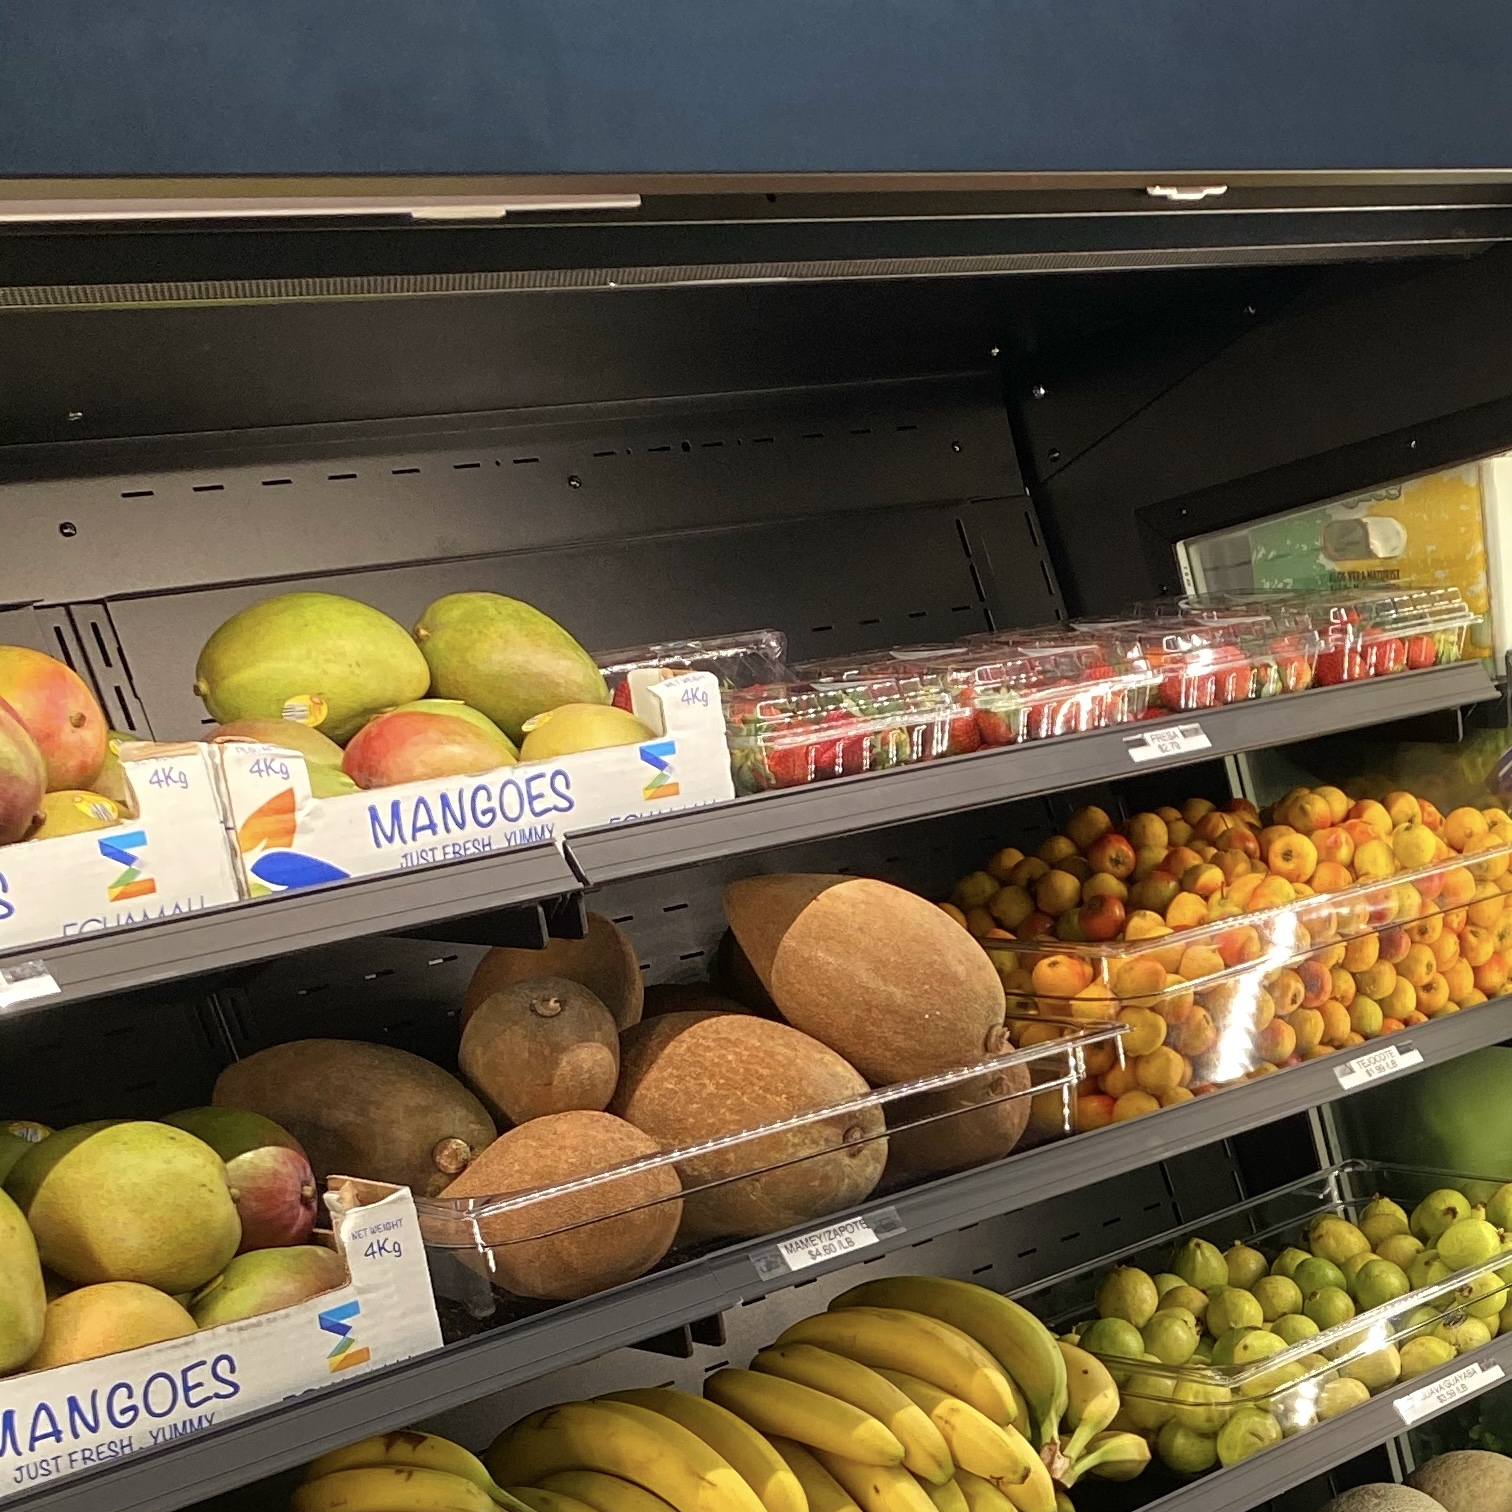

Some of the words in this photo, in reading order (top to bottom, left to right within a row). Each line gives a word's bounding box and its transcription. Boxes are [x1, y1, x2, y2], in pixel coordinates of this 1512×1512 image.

[681, 687, 709, 707] 4Kg
[1149, 731, 1179, 743] FRESA
[149, 767, 189, 789] 4Kg
[249, 757, 290, 780] 4Kg
[368, 769, 575, 849] MANGOES
[504, 823, 556, 846] YUMMY
[1355, 1048, 1396, 1070] TEJOCOTE
[351, 1227, 369, 1240] NET
[369, 1218, 403, 1235] WEIGHT
[783, 1218, 869, 1255] MAMEY/ZAPOTE
[364, 1237, 403, 1260] 4Kg
[807, 1243, 838, 1260] $4.60
[838, 1236, 856, 1251] /LB
[14, 1455, 63, 1484] JUST
[149, 1411, 216, 1446] YUMMY
